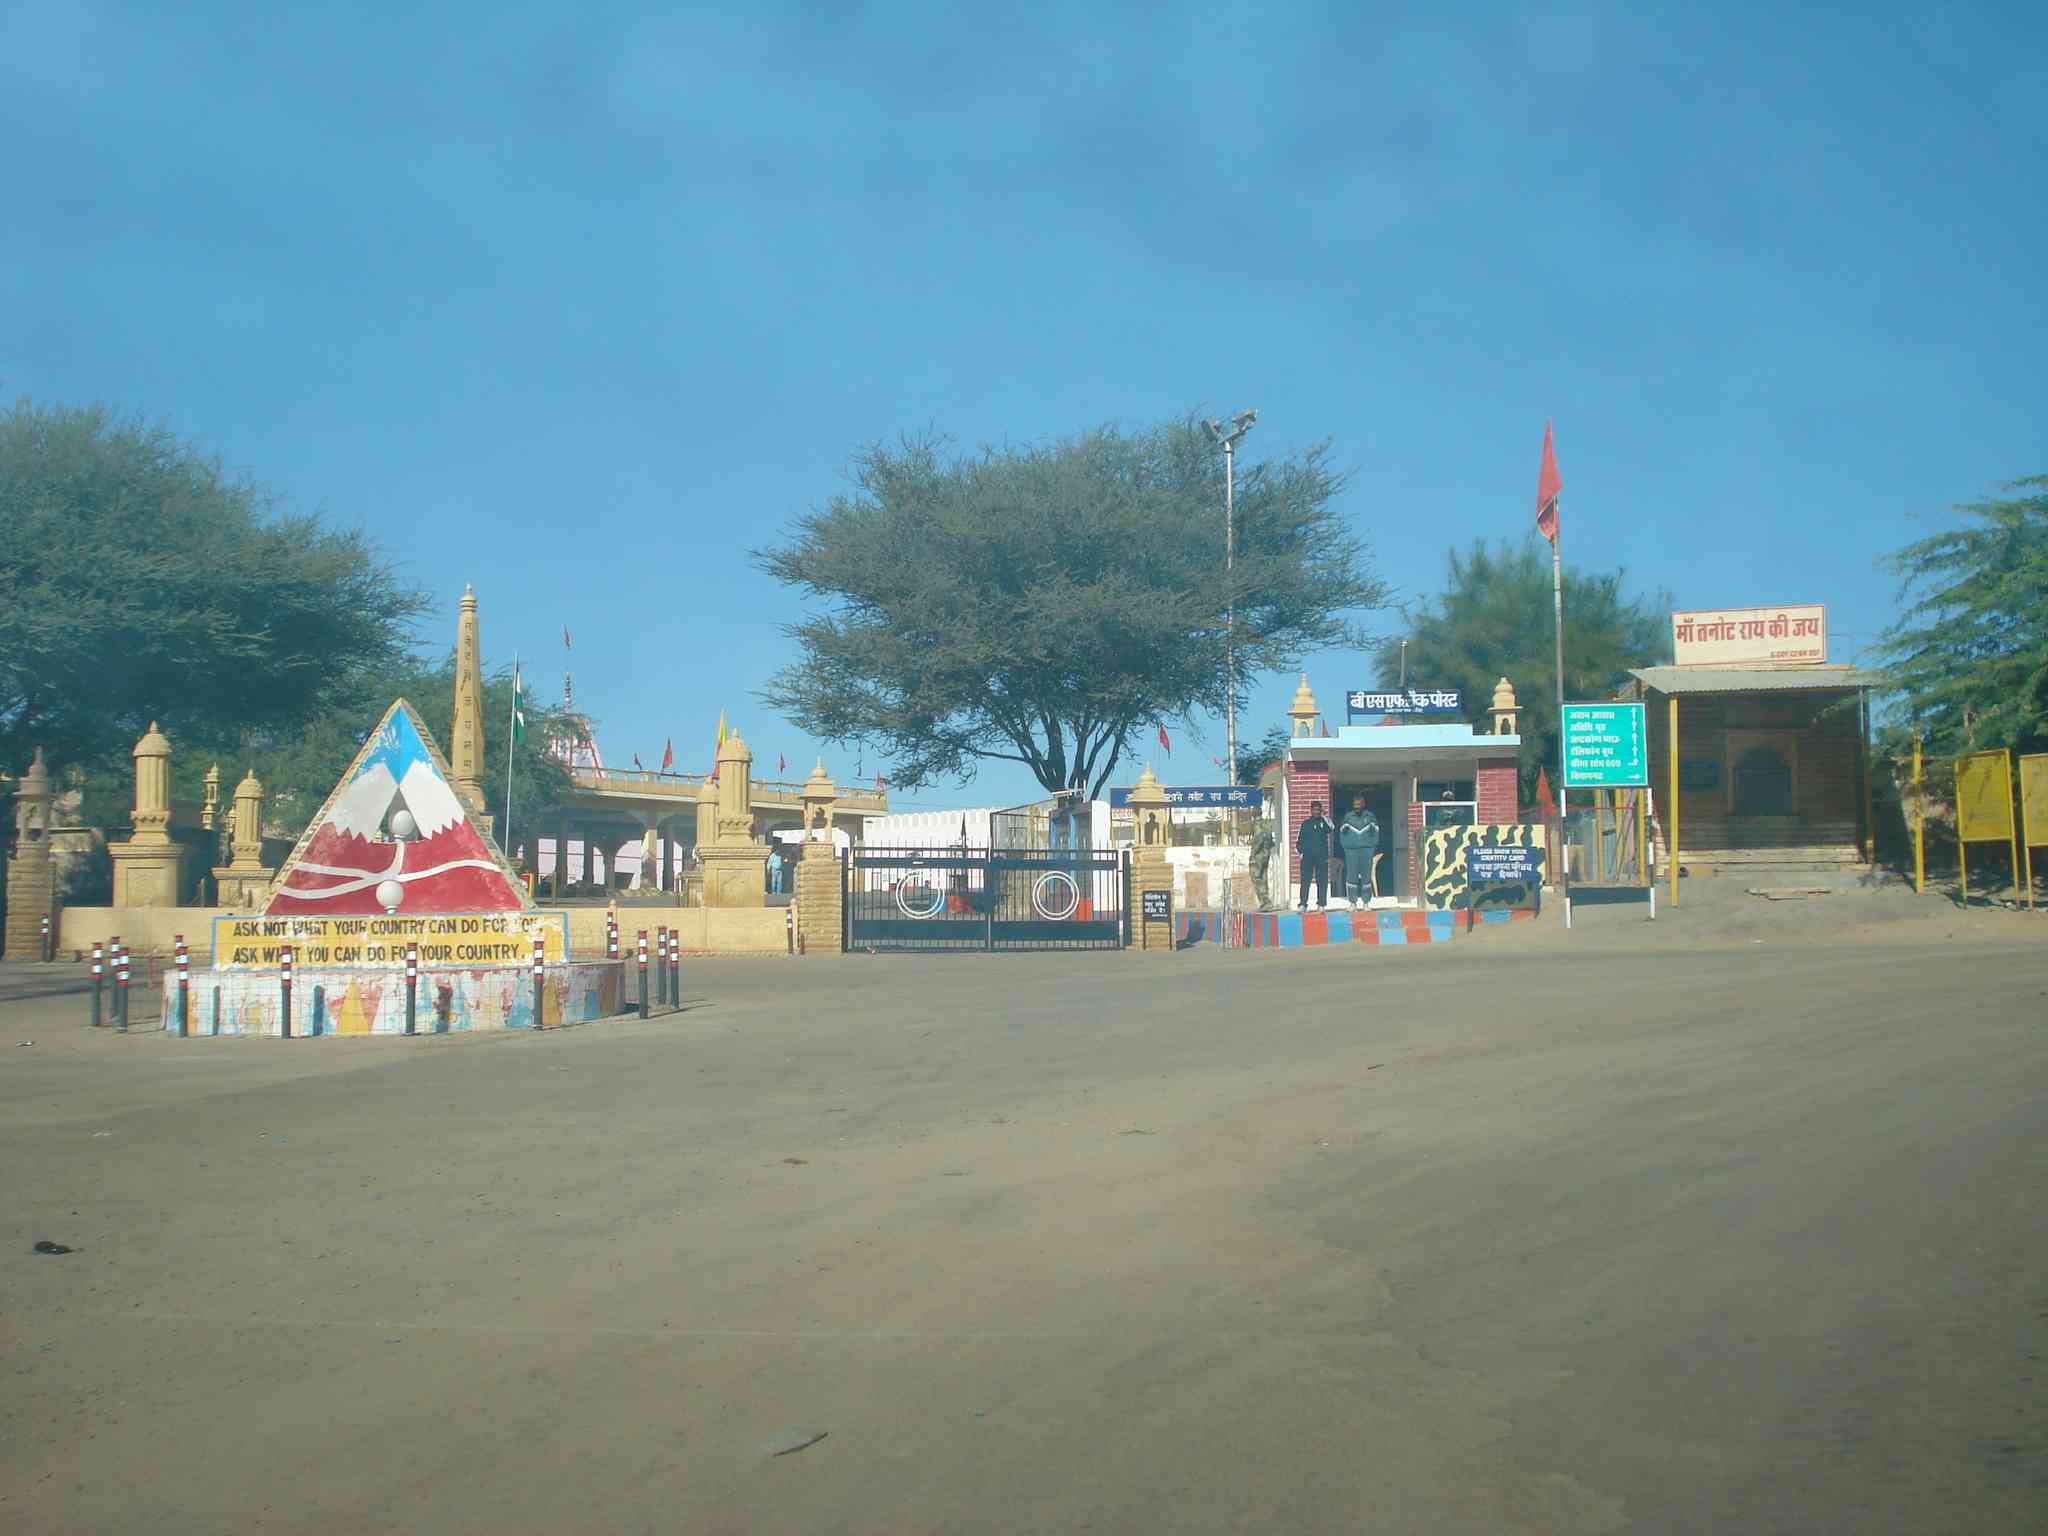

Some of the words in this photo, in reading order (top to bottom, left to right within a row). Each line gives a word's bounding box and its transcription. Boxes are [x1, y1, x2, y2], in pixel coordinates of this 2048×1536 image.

[1697, 616, 1737, 642] तनोट
[1739, 620, 1766, 640] राय
[1768, 613, 1789, 639] की
[1791, 618, 1820, 637] जय
[1428, 689, 1458, 708] पोस्ट
[233, 922, 260, 937] ASK
[264, 921, 288, 936] NOT
[292, 920, 329, 936] WHAT
[335, 920, 367, 936] YOUR
[371, 919, 426, 935] COUNTRY
[429, 919, 457, 933] CAN
[461, 918, 479, 933] DO
[233, 947, 260, 963] ASK
[307, 945, 329, 962] YOU
[334, 945, 361, 962] CAN
[368, 946, 387, 961] DO
[419, 944, 453, 961] YOUR
